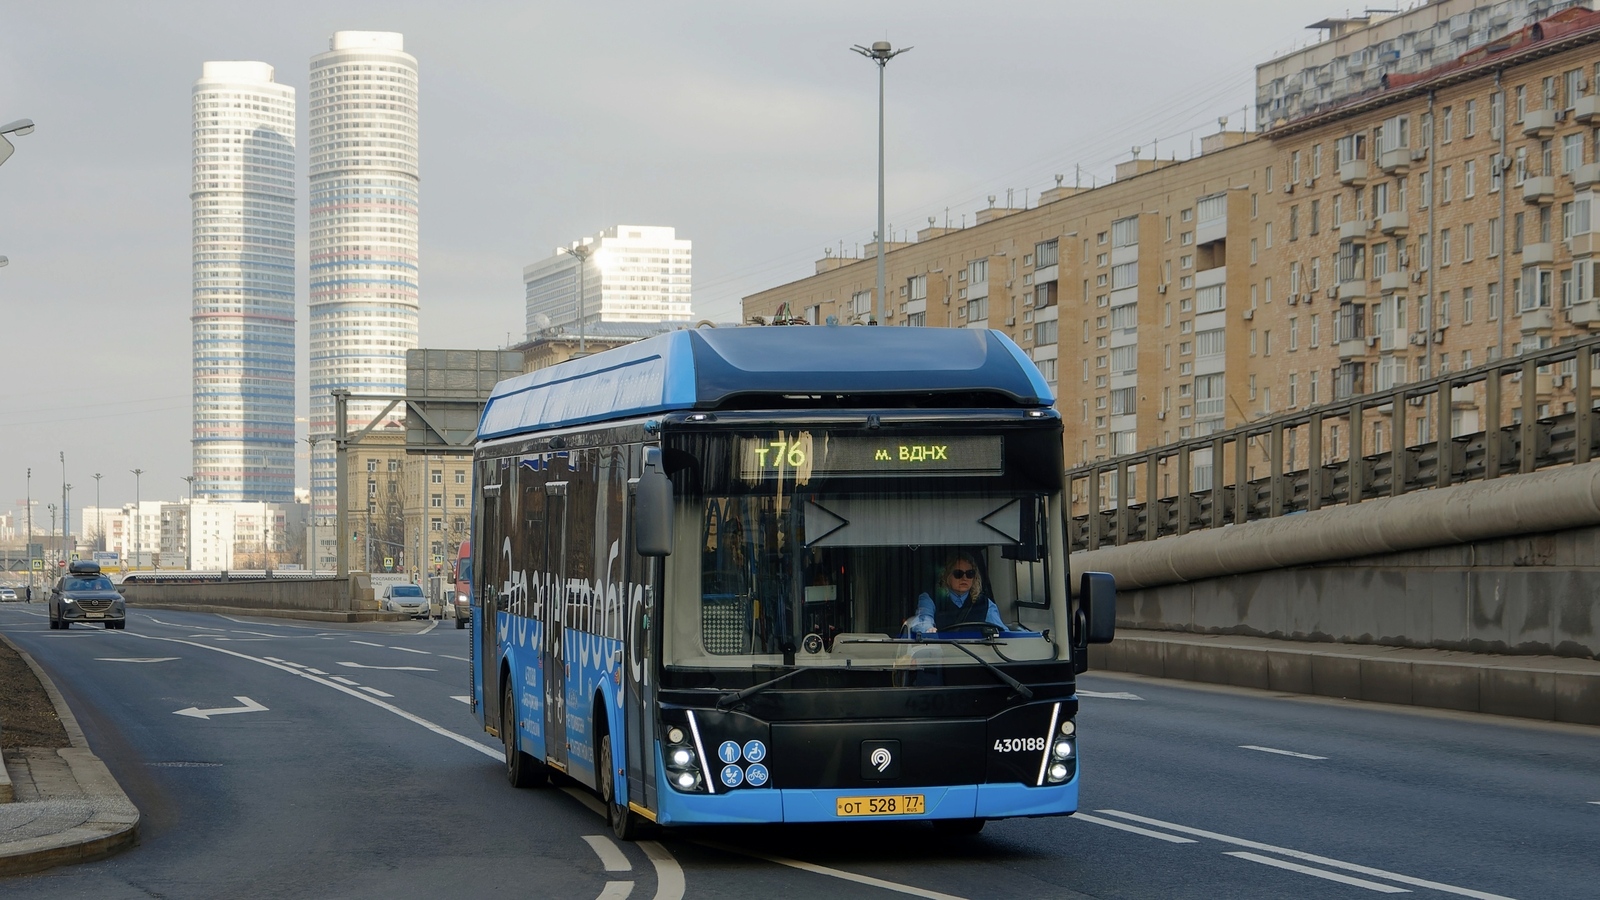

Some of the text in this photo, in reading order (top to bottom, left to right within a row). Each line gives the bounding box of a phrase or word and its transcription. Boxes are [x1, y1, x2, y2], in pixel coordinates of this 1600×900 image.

[755, 441, 806, 467] т76
[875, 445, 947, 462] м. ВДНХ
[500, 536, 528, 647] Это
[994, 737, 1045, 753] 430188
[844, 796, 919, 814] ОТ 528 77
